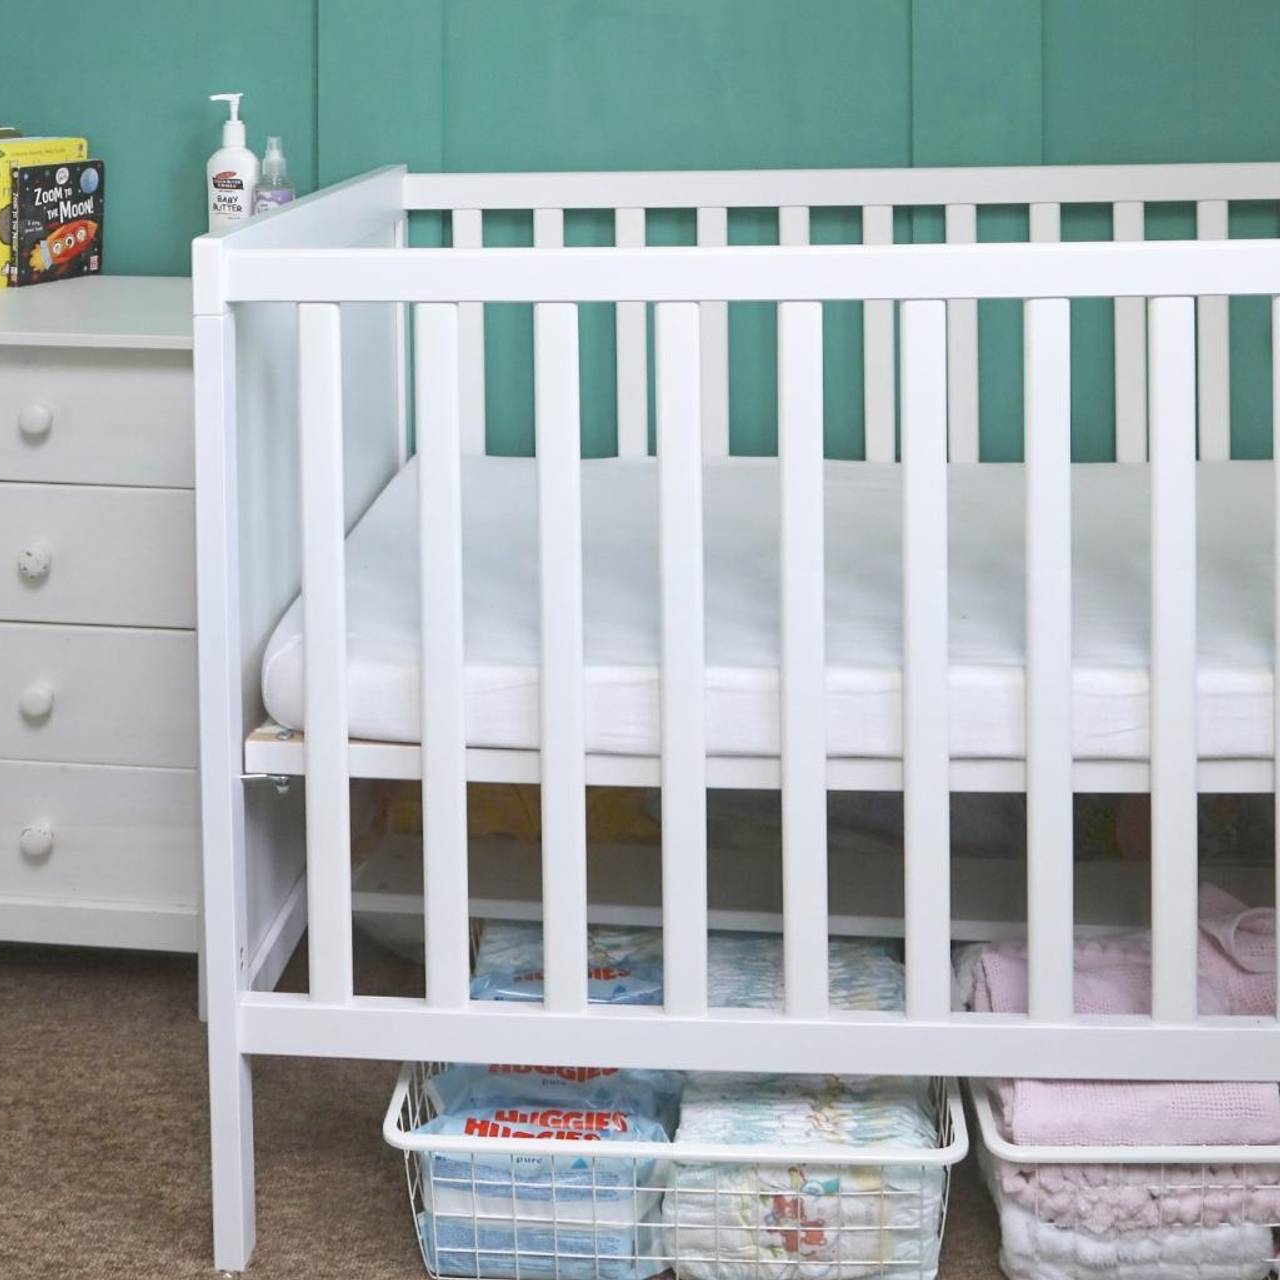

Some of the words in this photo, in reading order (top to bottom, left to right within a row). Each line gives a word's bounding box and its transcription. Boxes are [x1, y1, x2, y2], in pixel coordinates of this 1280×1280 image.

[34, 187, 62, 206] ZOOM
[64, 187, 73, 198] TO
[217, 194, 239, 203] BABY
[47, 209, 59, 220] THE
[59, 196, 95, 223] MOON!
[213, 203, 243, 212] BUTTER
[516, 1156, 544, 1164] pure
